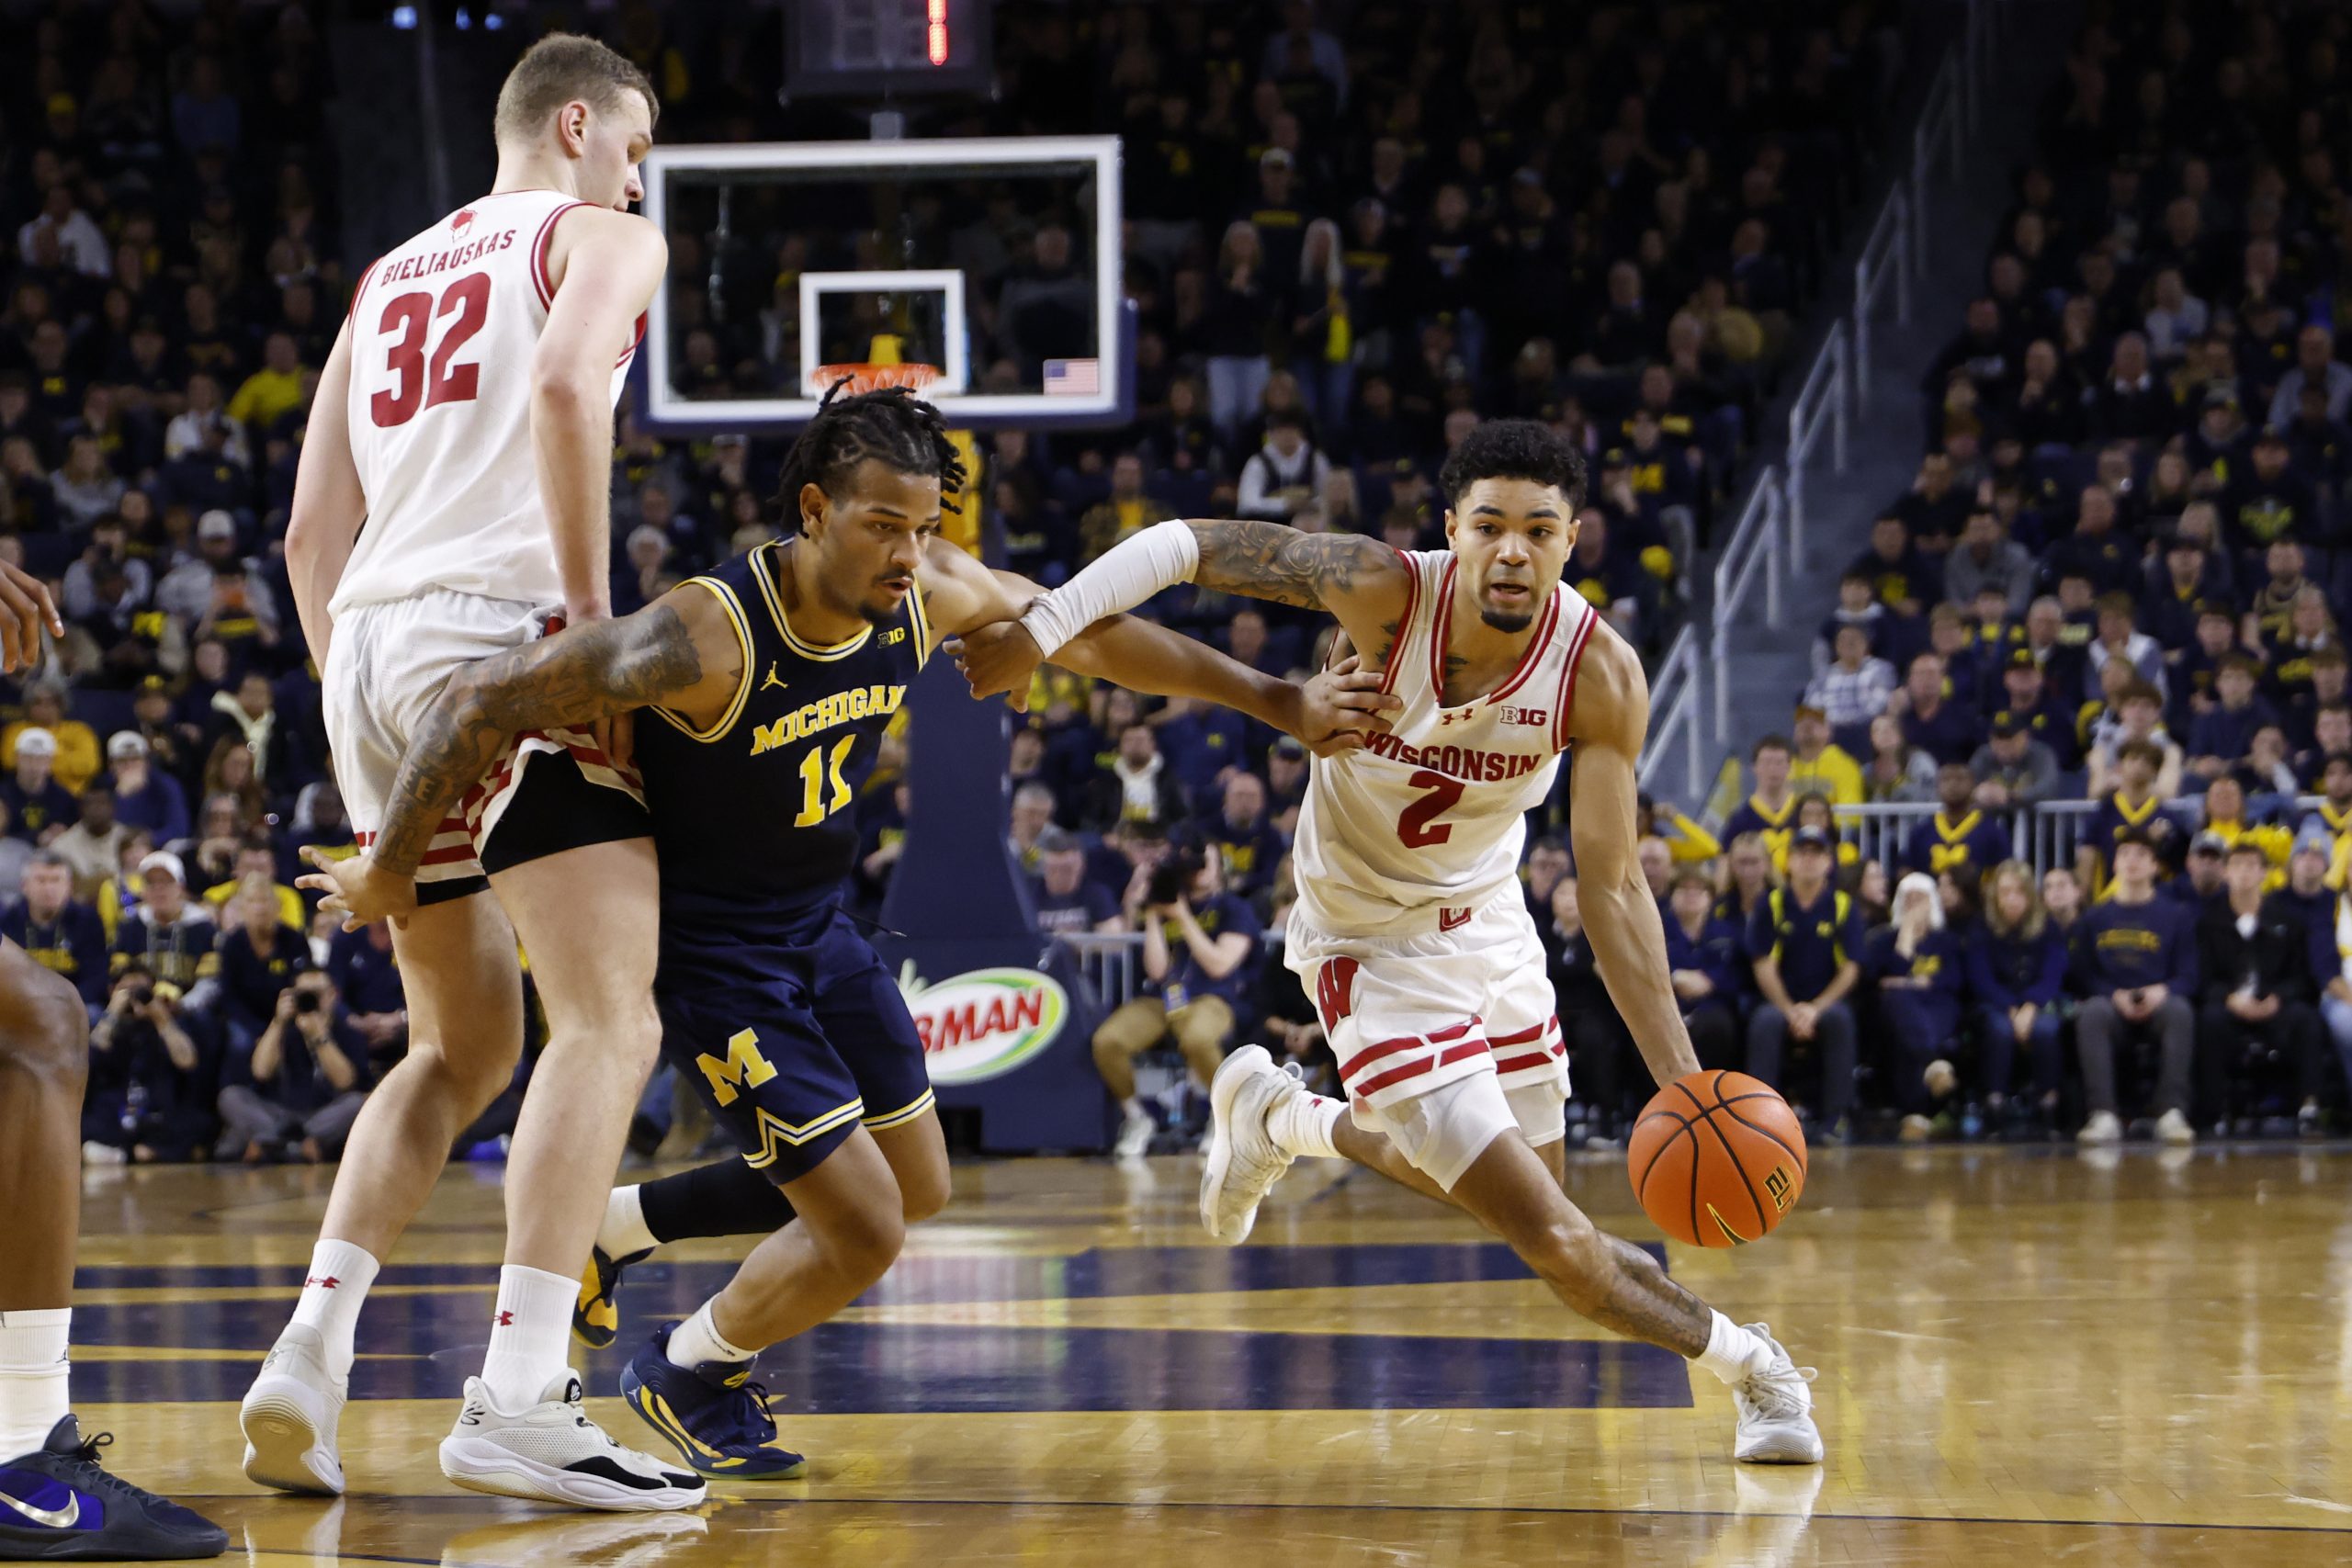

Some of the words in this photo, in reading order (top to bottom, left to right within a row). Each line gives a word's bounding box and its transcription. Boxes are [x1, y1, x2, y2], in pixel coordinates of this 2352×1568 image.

[381, 230, 516, 287] BIELIAUSKAS
[371, 272, 492, 427] 32
[750, 684, 907, 756] MICHIGAN
[1363, 729, 1542, 782] WISCONSIN
[794, 734, 856, 828] 11
[1397, 770, 1466, 849] 2
[695, 1026, 778, 1108] M
